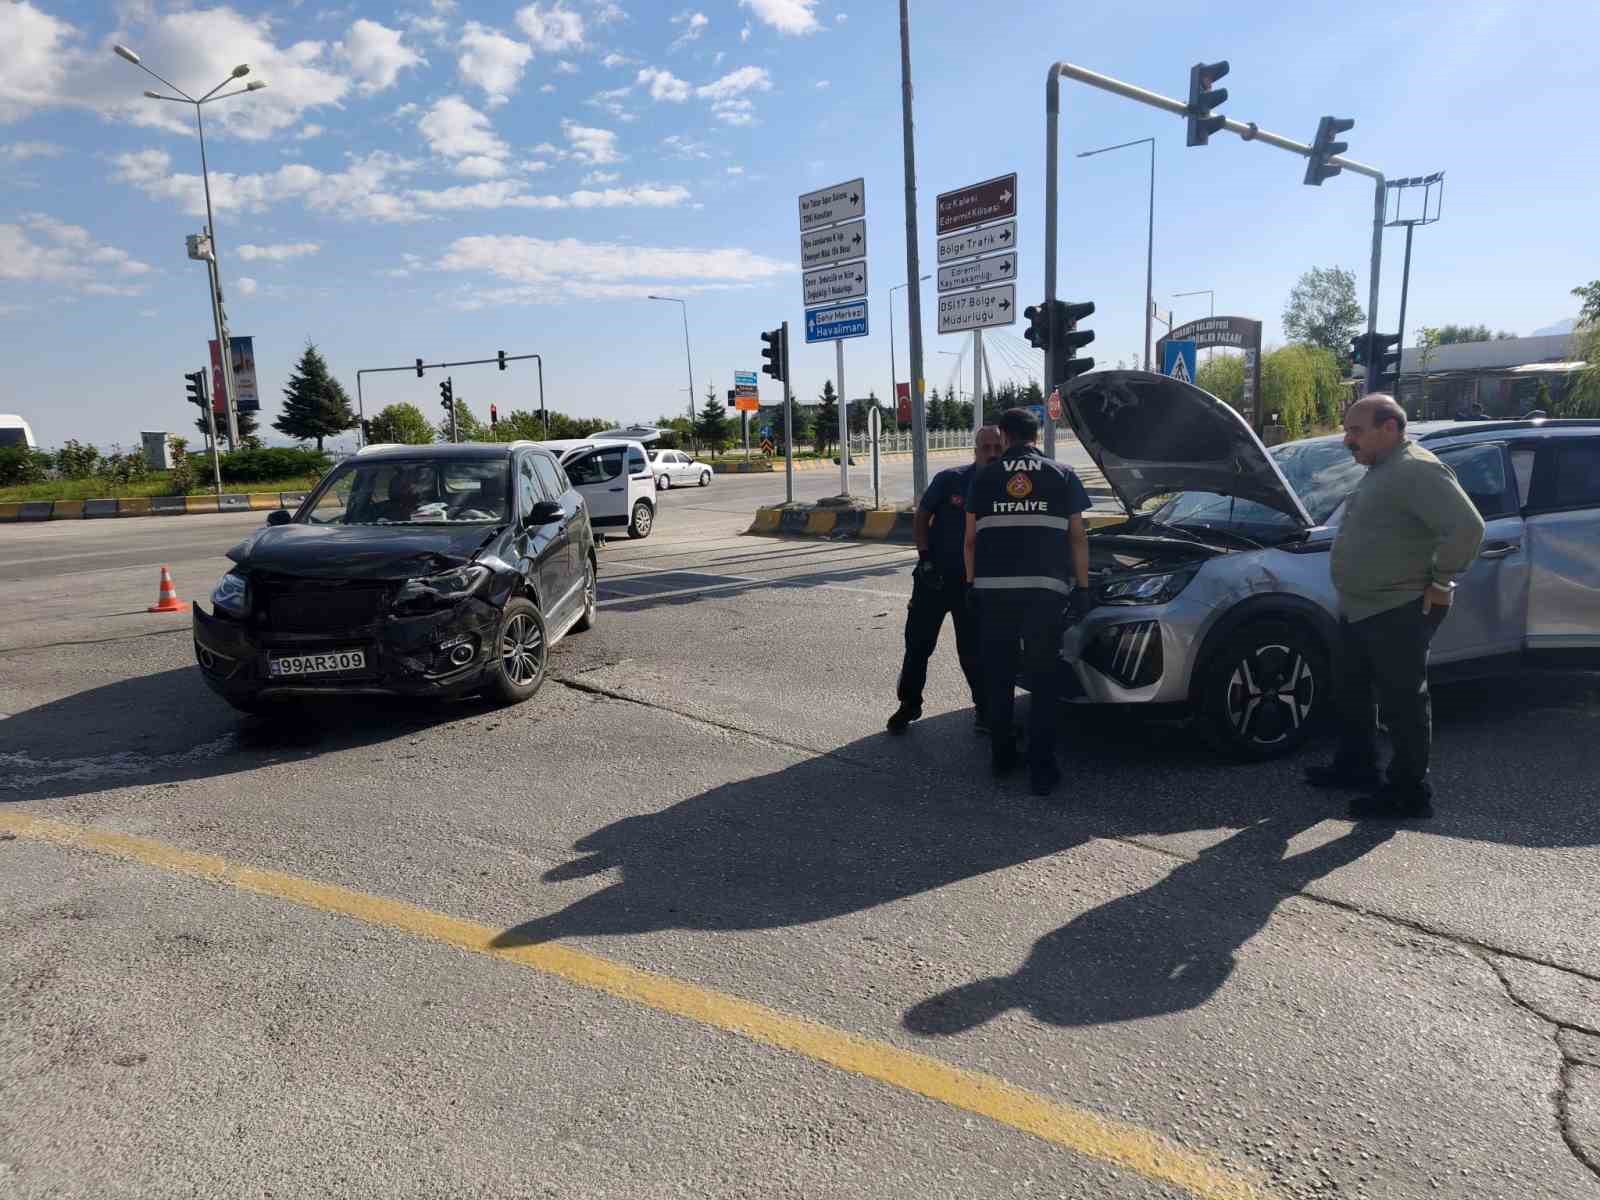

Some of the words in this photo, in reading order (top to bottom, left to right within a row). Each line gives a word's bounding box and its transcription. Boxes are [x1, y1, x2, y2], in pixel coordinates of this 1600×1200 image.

[940, 244, 964, 256] Bölge
[967, 234, 994, 249] Trafik
[951, 264, 981, 277] Edremit
[969, 295, 996, 307] Bölge
[834, 308, 864, 321] Merkezi
[816, 323, 865, 337] Havalimanı
[1003, 459, 1042, 471] VAN
[993, 500, 1049, 513] İTFAİYE
[281, 653, 362, 673] 99AR309
